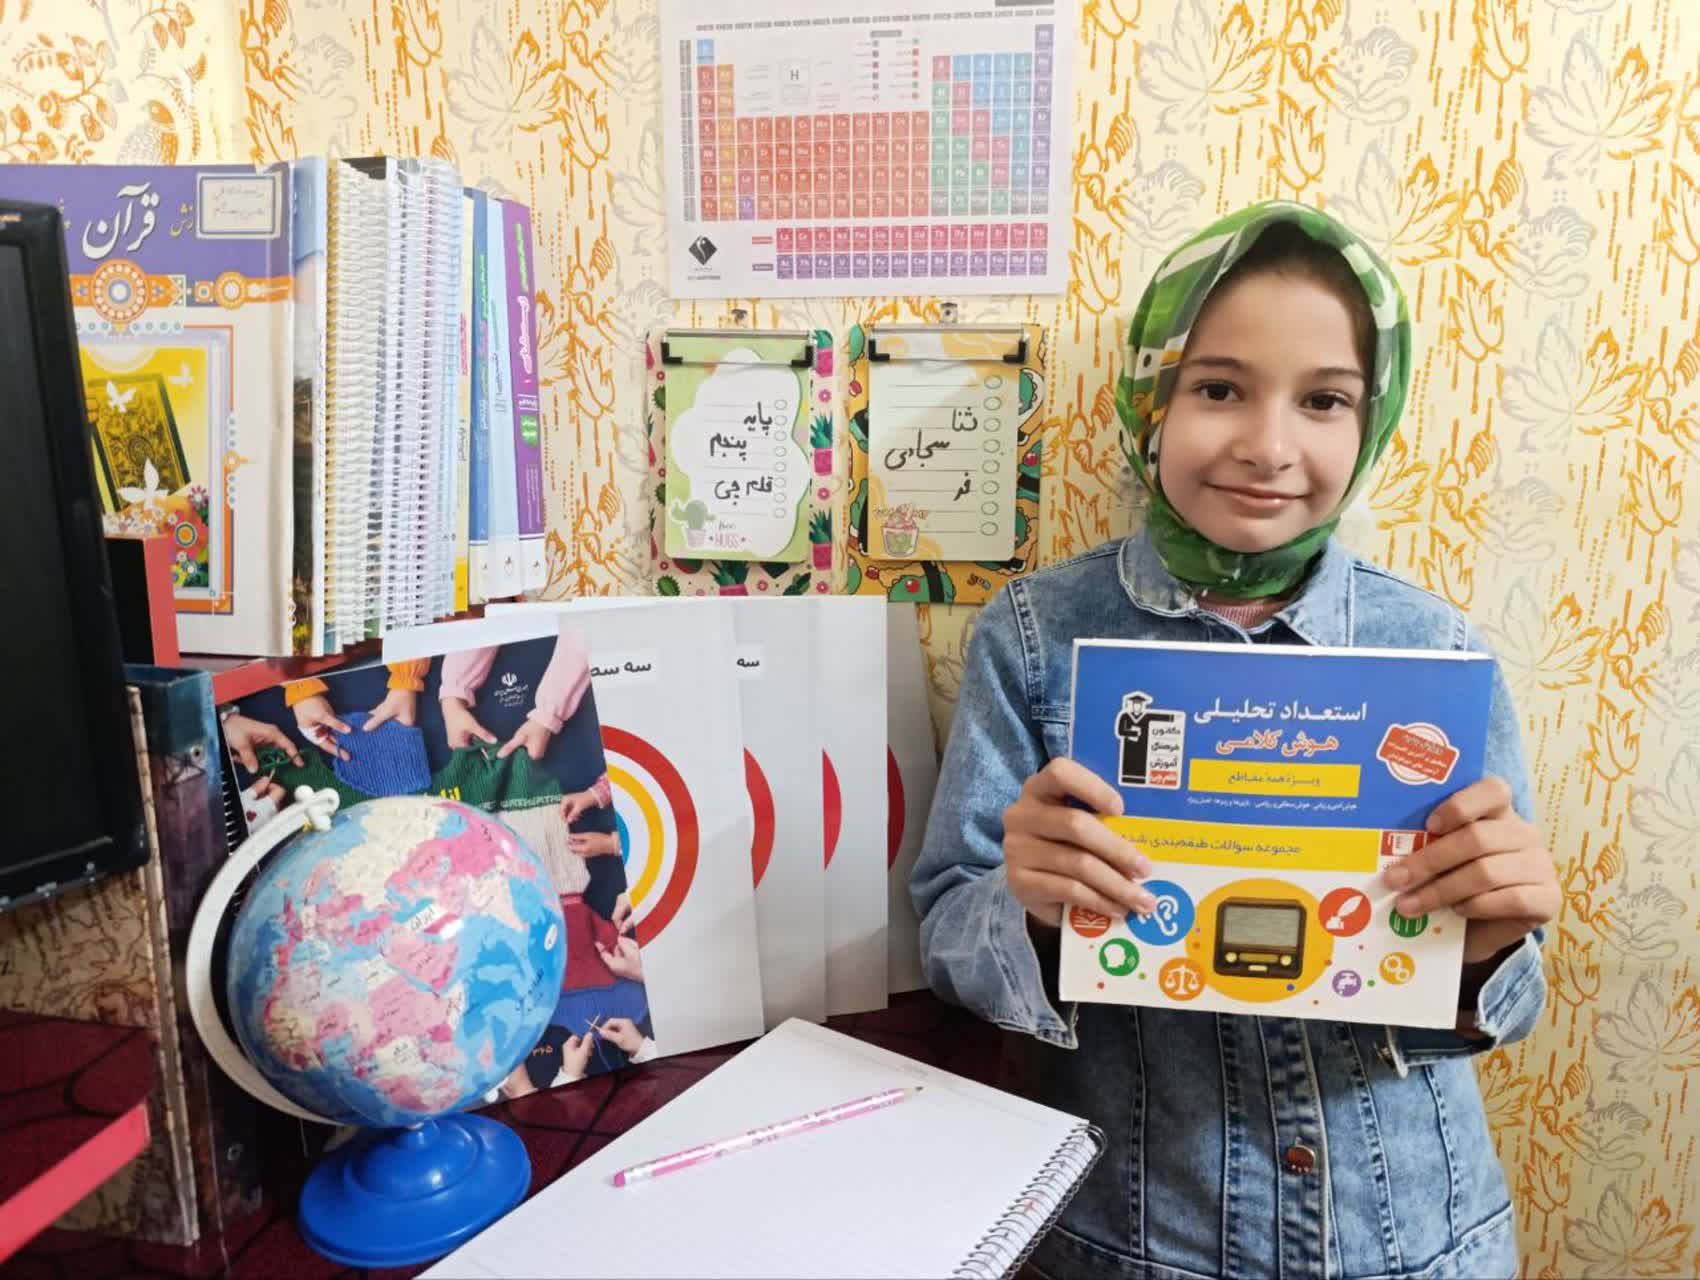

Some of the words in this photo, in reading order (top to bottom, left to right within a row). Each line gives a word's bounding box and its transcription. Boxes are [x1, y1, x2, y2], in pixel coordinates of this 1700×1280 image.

[789, 69, 800, 81] H
[82, 182, 160, 260] قرآن
[744, 401, 772, 436] پایه
[952, 406, 978, 431] ثنا
[709, 432, 747, 461] پنجم
[884, 429, 950, 470] سجادی
[714, 479, 740, 506] چی
[746, 476, 774, 496] قلم
[624, 660, 652, 673] سه
[736, 657, 760, 668] سه
[1193, 697, 1276, 723] تحلیلی
[1280, 700, 1368, 721] استعداد
[1215, 728, 1283, 755] کلامی
[1281, 730, 1340, 758] هوش
[1150, 757, 1178, 769] آموزش
[1212, 839, 1252, 853] سوالات
[1255, 842, 1302, 856] مجموعه
